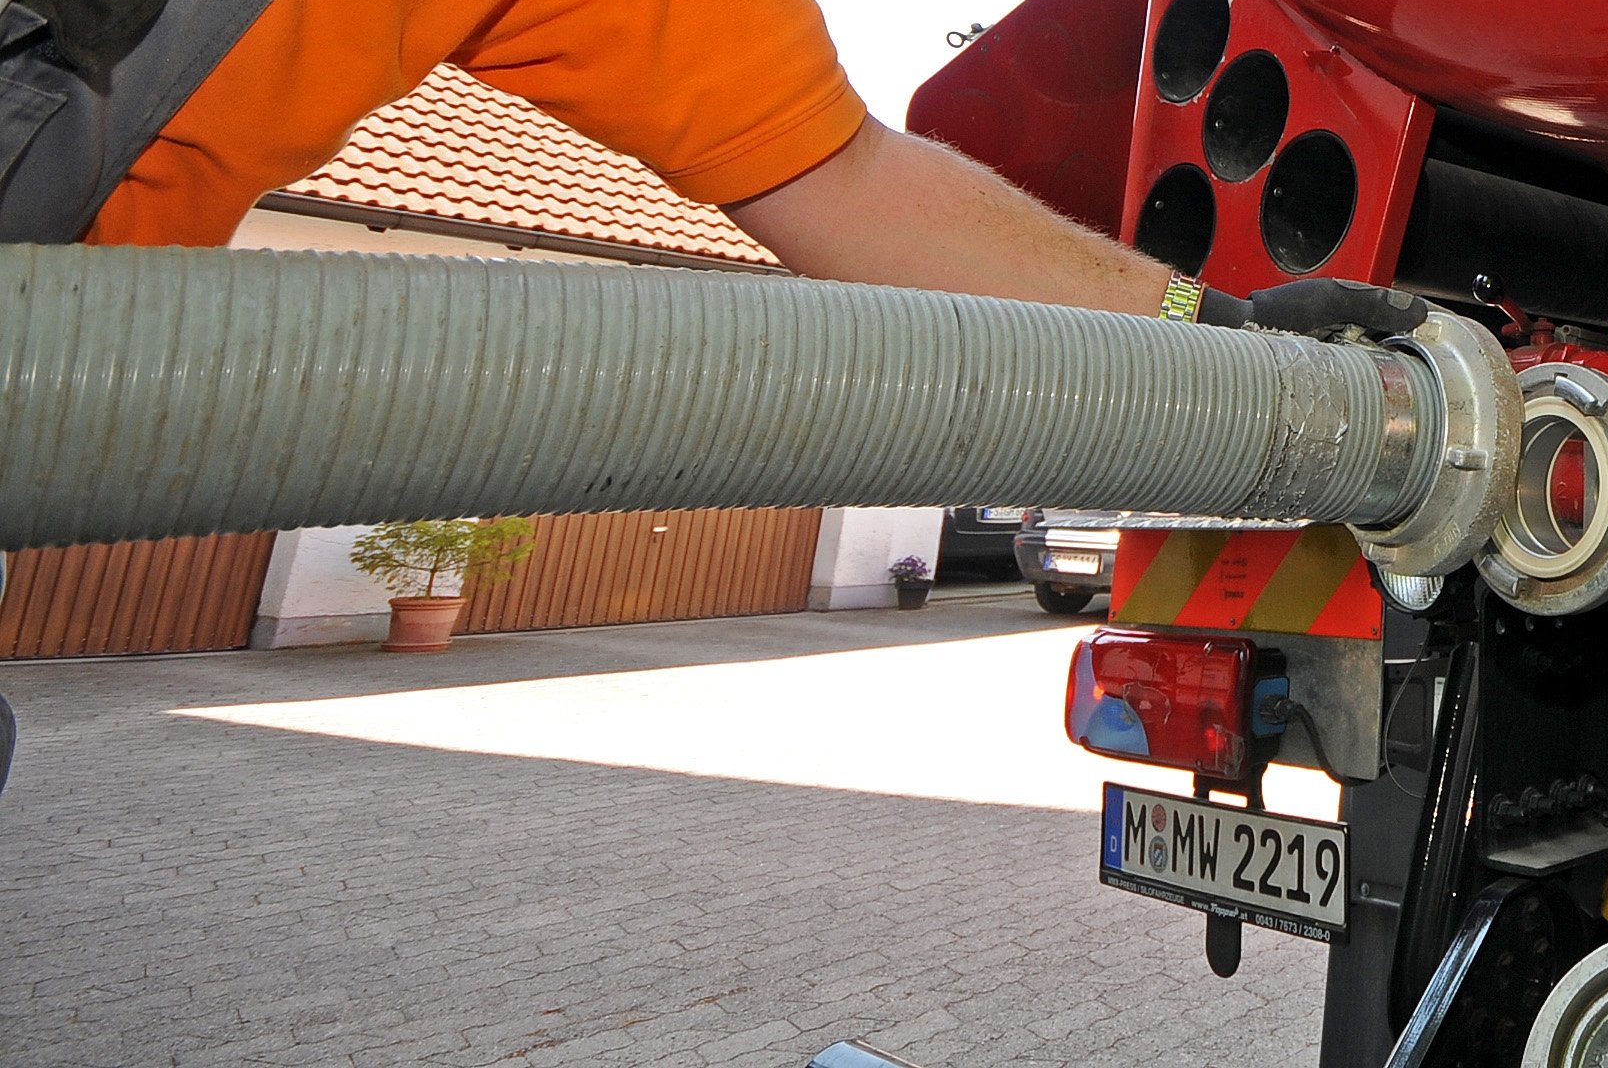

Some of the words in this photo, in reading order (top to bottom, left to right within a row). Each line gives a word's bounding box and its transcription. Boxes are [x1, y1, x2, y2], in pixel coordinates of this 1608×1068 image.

[1110, 835, 1118, 853] D
[1123, 800, 1148, 866] M
[1171, 809, 1221, 883] MW
[1232, 823, 1341, 908] 2219
[1255, 912, 1273, 928] 0043
[1303, 924, 1331, 942] 2308-0
